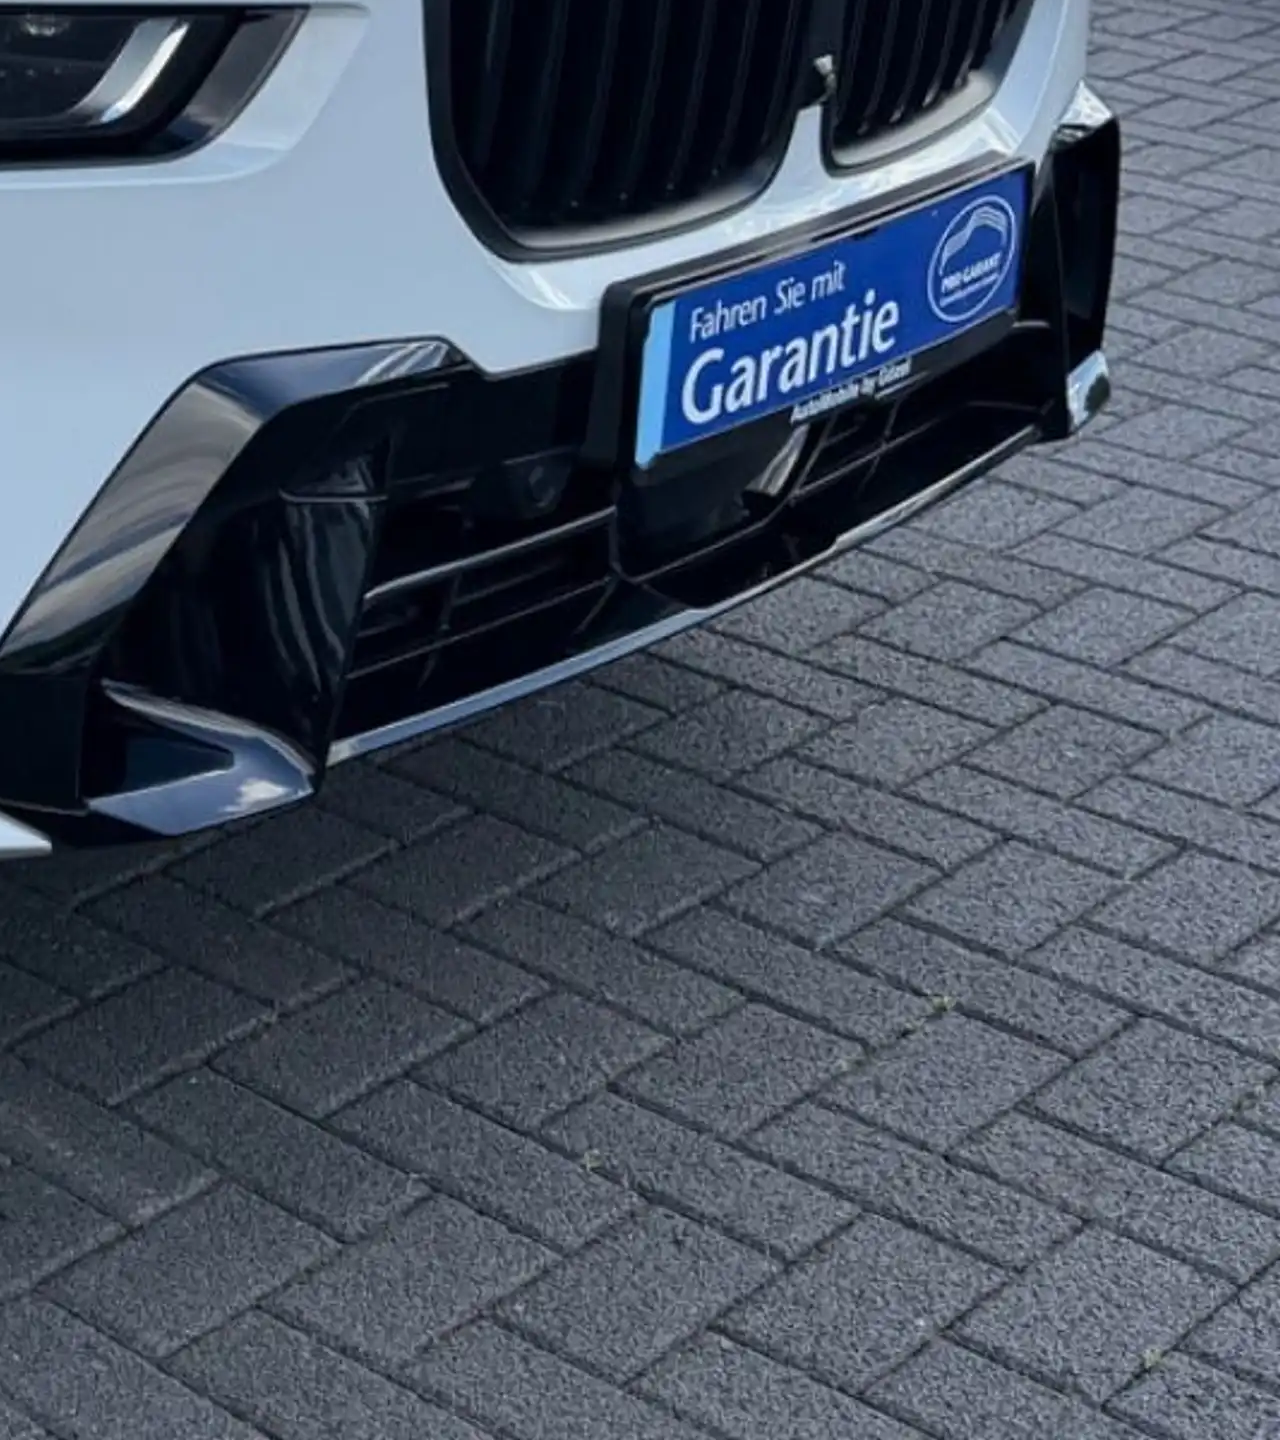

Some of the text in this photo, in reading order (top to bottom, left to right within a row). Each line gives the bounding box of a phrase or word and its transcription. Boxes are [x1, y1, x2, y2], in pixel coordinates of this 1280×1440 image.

[690, 259, 847, 343] Fahren Sie mit
[682, 288, 900, 425] Garantie
